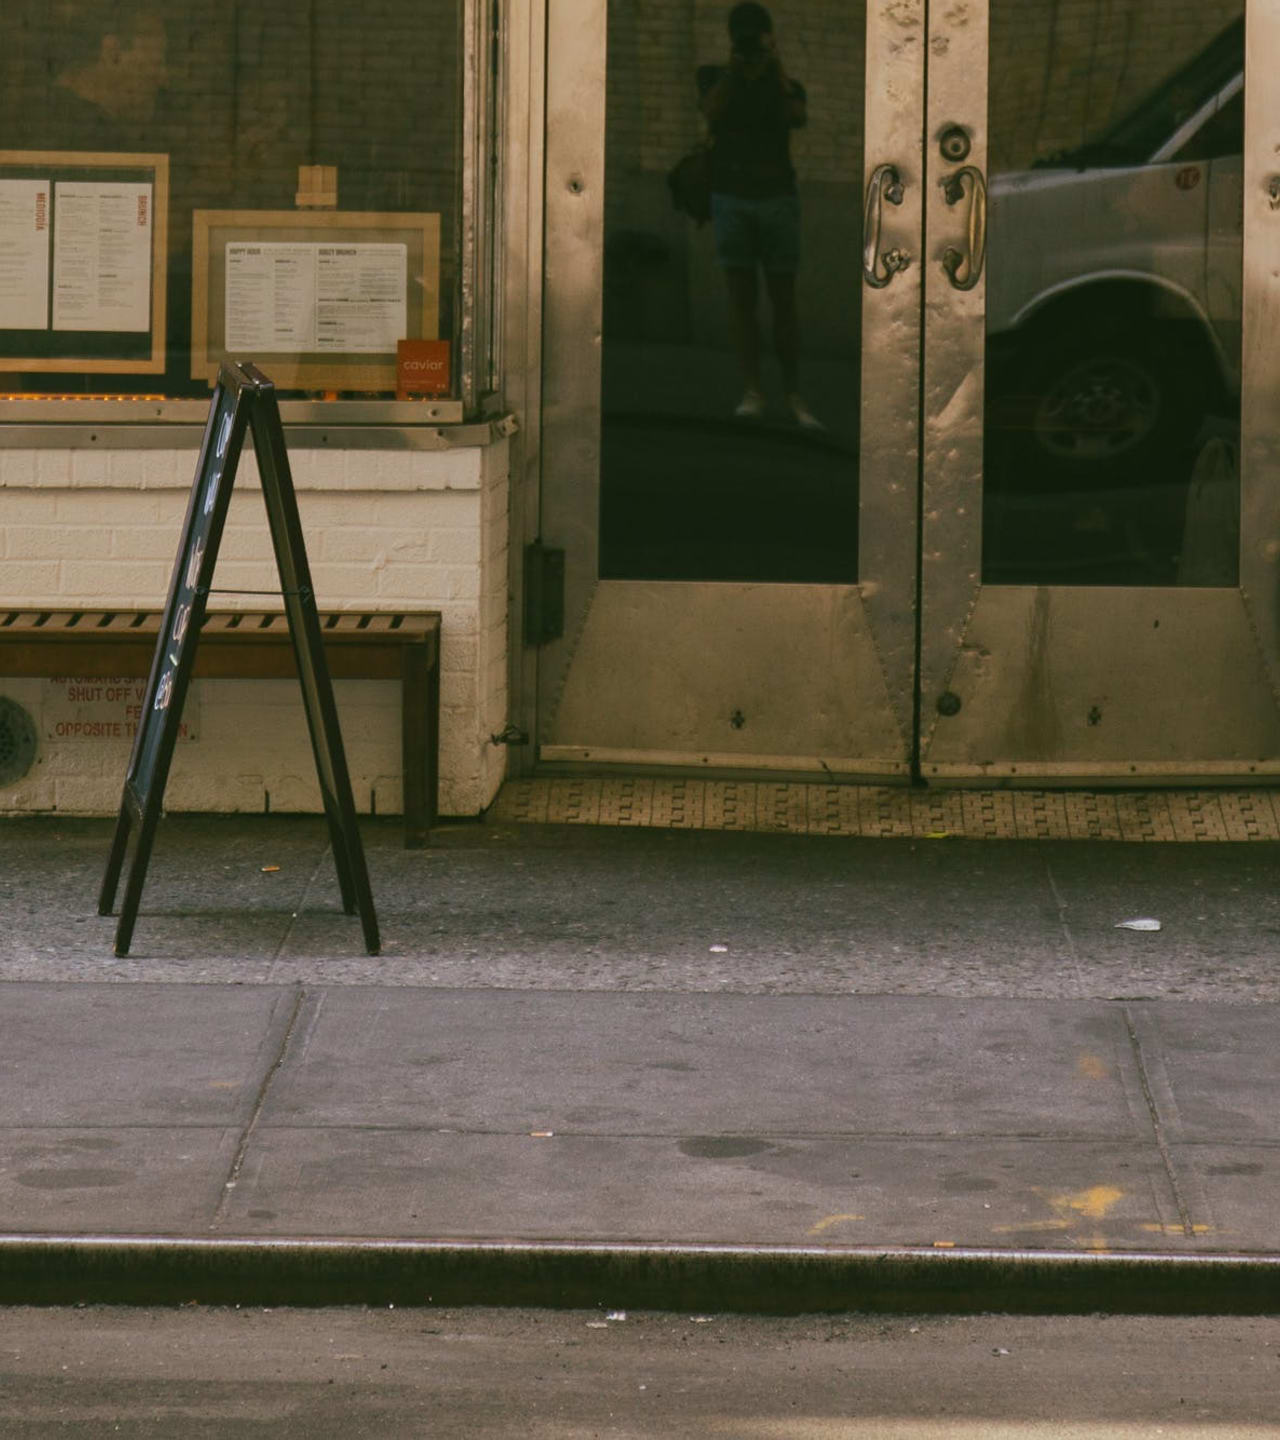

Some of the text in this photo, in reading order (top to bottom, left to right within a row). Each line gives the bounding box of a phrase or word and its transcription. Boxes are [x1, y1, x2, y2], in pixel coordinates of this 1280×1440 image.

[403, 357, 444, 371] caviar
[68, 687, 103, 702] SHUT
[106, 687, 131, 702] OFF
[55, 722, 122, 738] OPPOSITE
